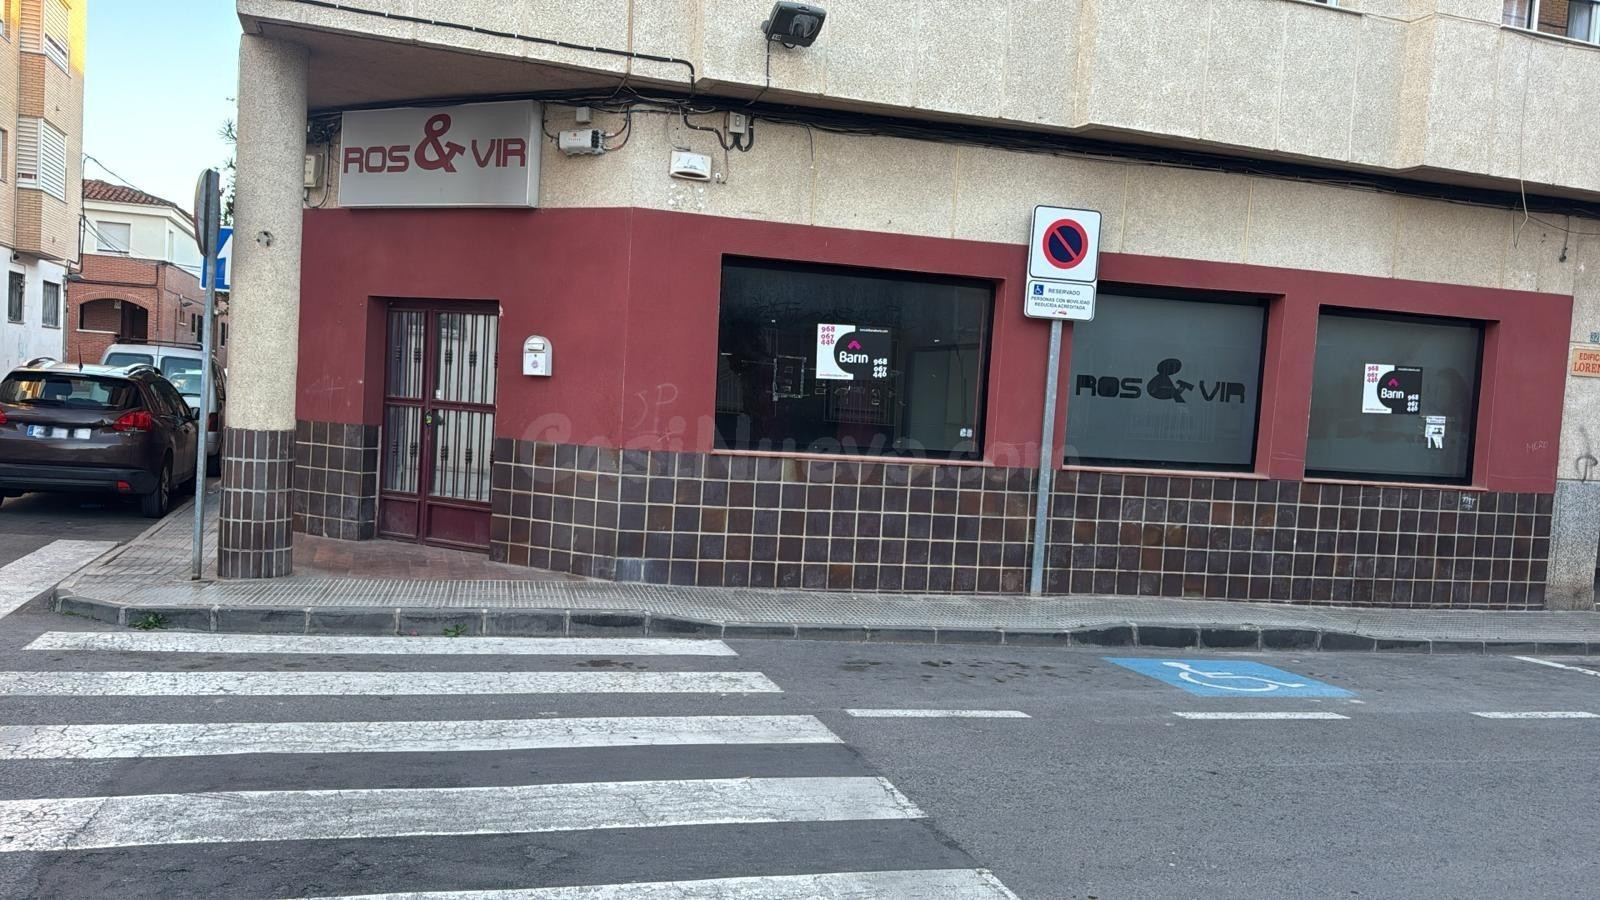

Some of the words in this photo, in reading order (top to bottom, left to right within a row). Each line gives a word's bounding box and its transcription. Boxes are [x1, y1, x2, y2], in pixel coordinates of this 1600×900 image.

[343, 145, 411, 173] ROS
[414, 113, 466, 173] &
[471, 137, 527, 168] VIR
[1048, 288, 1081, 296] RESERVADO
[839, 351, 869, 364] Barin
[873, 358, 888, 366] 968
[1075, 374, 1143, 399] ROS
[1146, 358, 1195, 403] &
[1199, 380, 1246, 404] VIR
[1381, 388, 1404, 399] Barin
